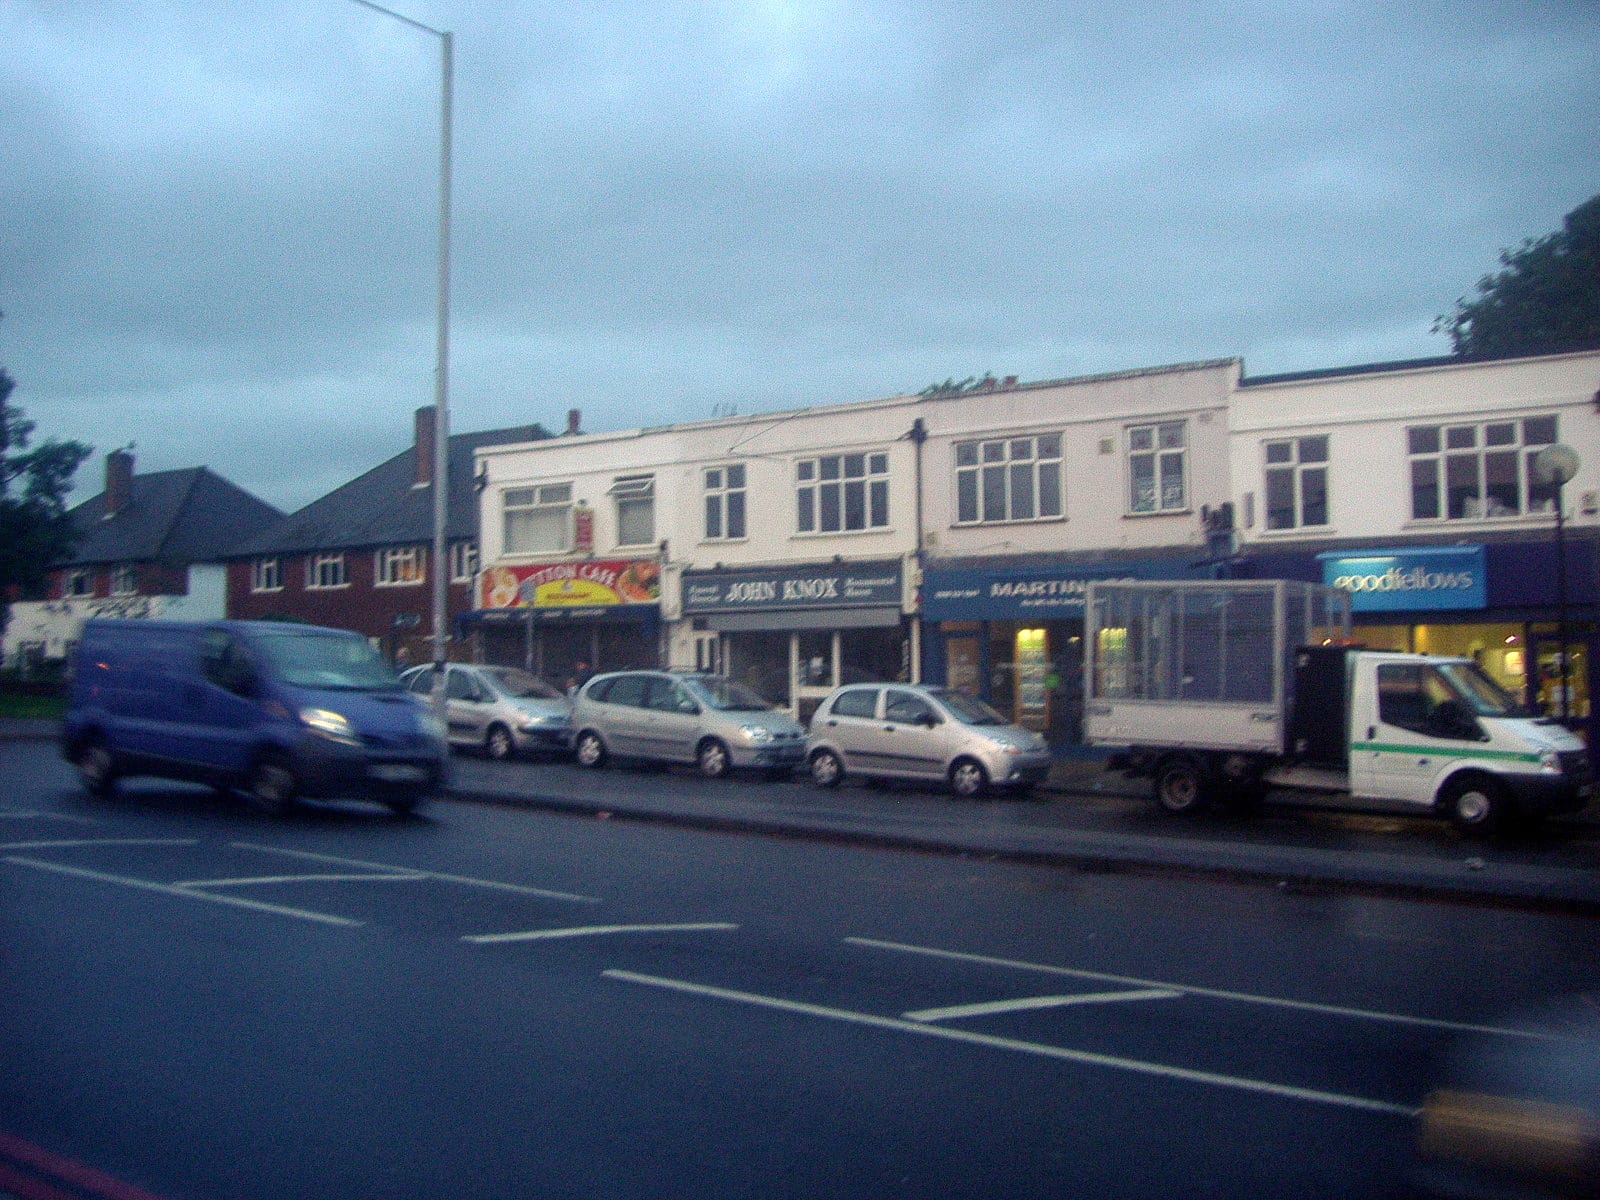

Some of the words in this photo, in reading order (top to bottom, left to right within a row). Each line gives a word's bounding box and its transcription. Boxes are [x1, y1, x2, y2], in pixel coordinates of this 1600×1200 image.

[725, 581, 778, 602] JOHN
[782, 577, 839, 600] KNOX
[990, 580, 1085, 597] MARTIN
